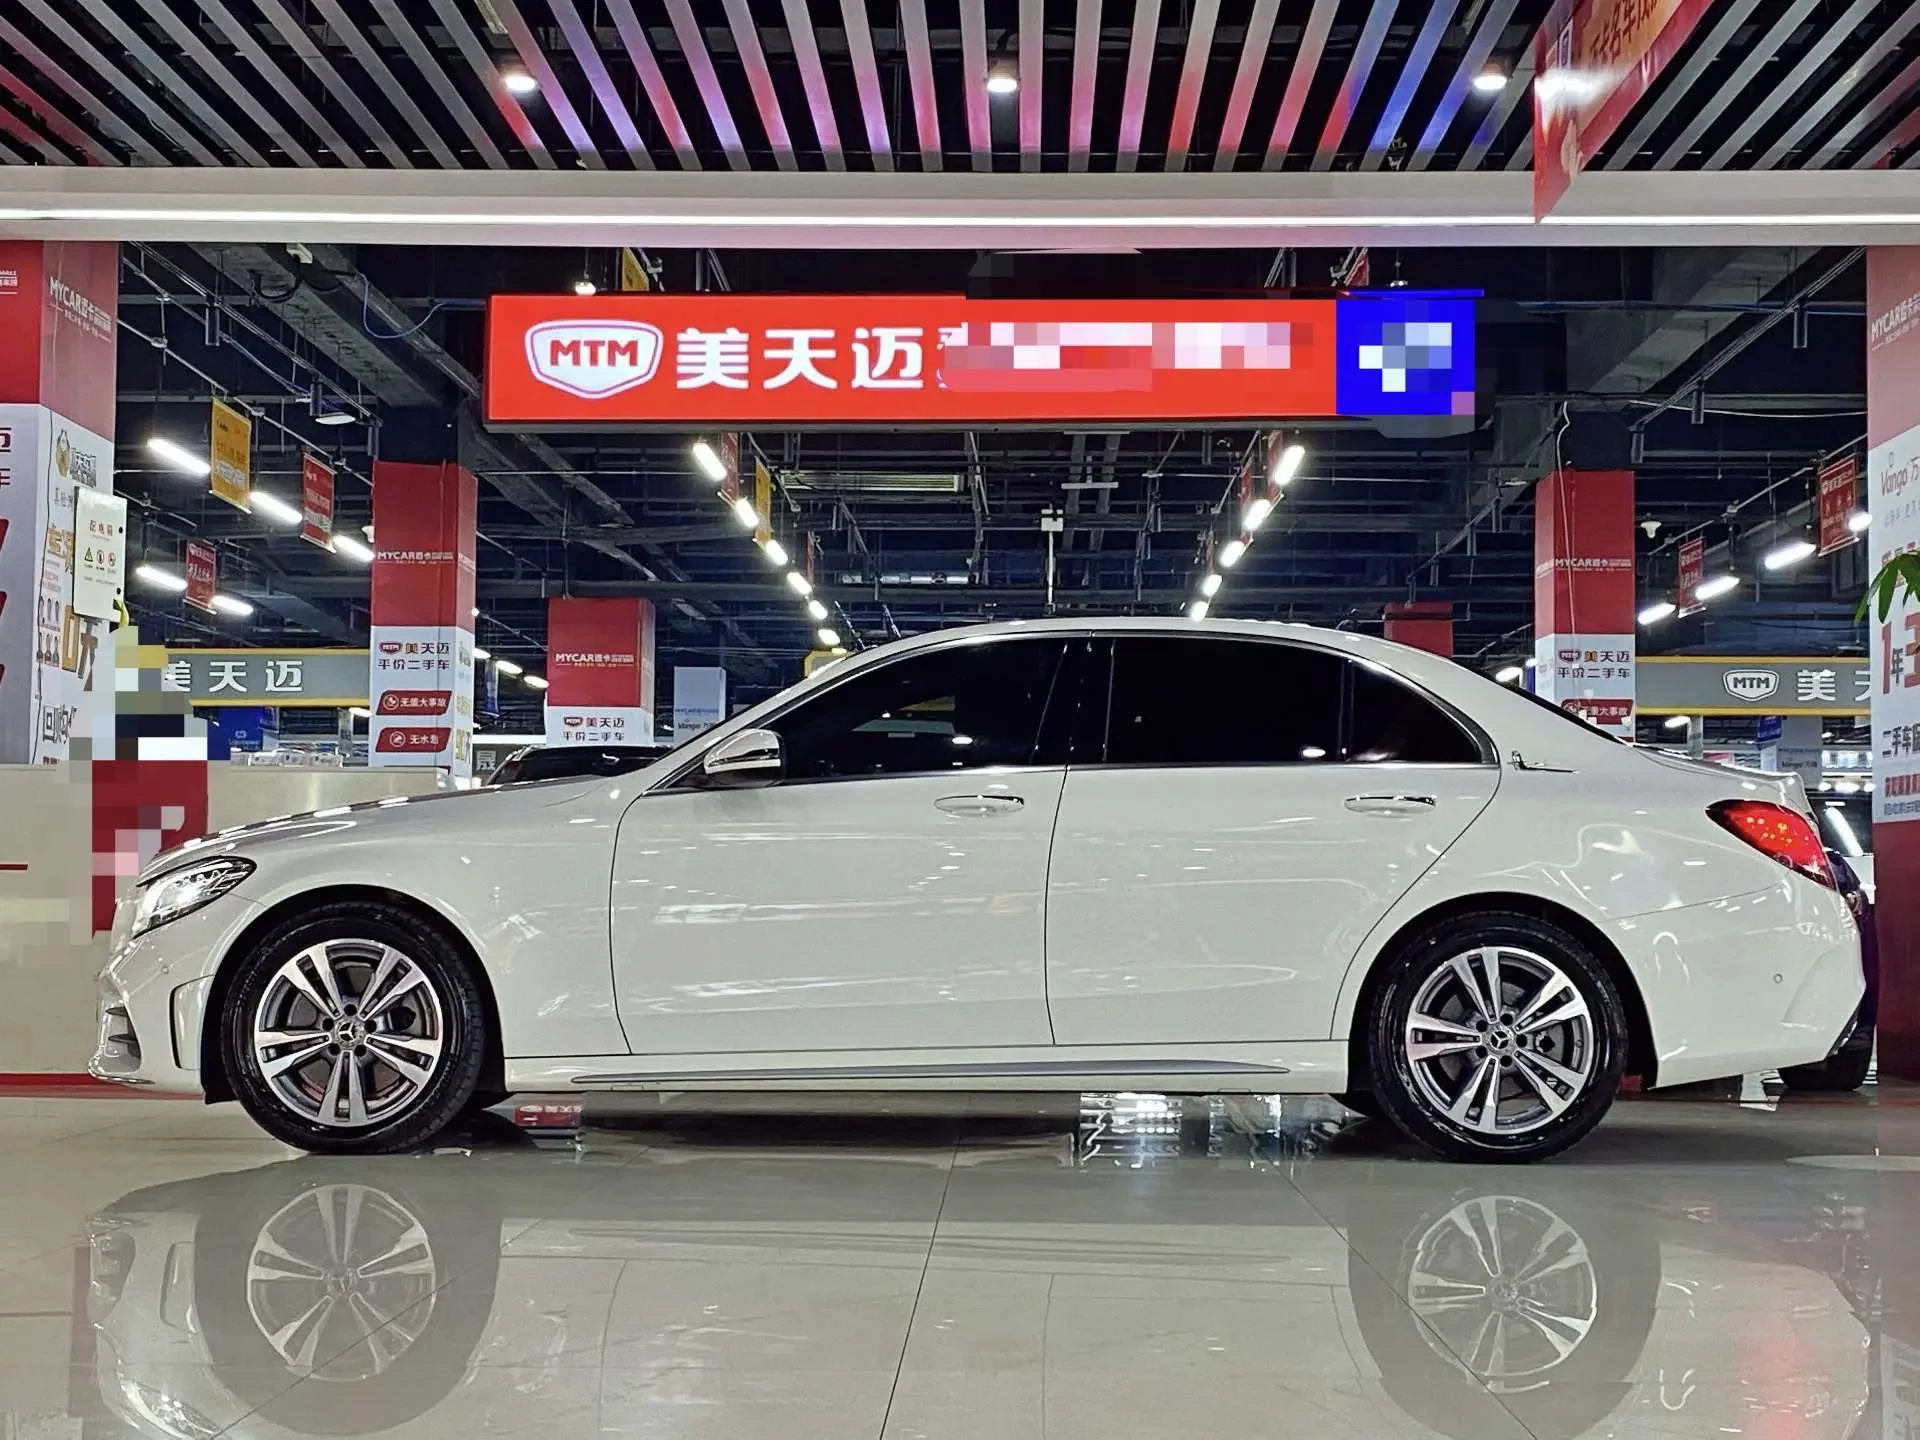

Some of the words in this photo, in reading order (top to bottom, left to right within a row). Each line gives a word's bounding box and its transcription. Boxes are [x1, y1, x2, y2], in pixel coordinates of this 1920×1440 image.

[549, 339, 638, 366] MTM
[676, 327, 944, 389] 美天迈
[404, 642, 450, 655] 美天迈
[1584, 650, 1631, 663] 美天迈
[377, 658, 450, 670] 平价二手车
[1557, 667, 1631, 679] 平价二手车
[1733, 677, 1770, 689] MTM
[585, 717, 625, 728] 美天迈
